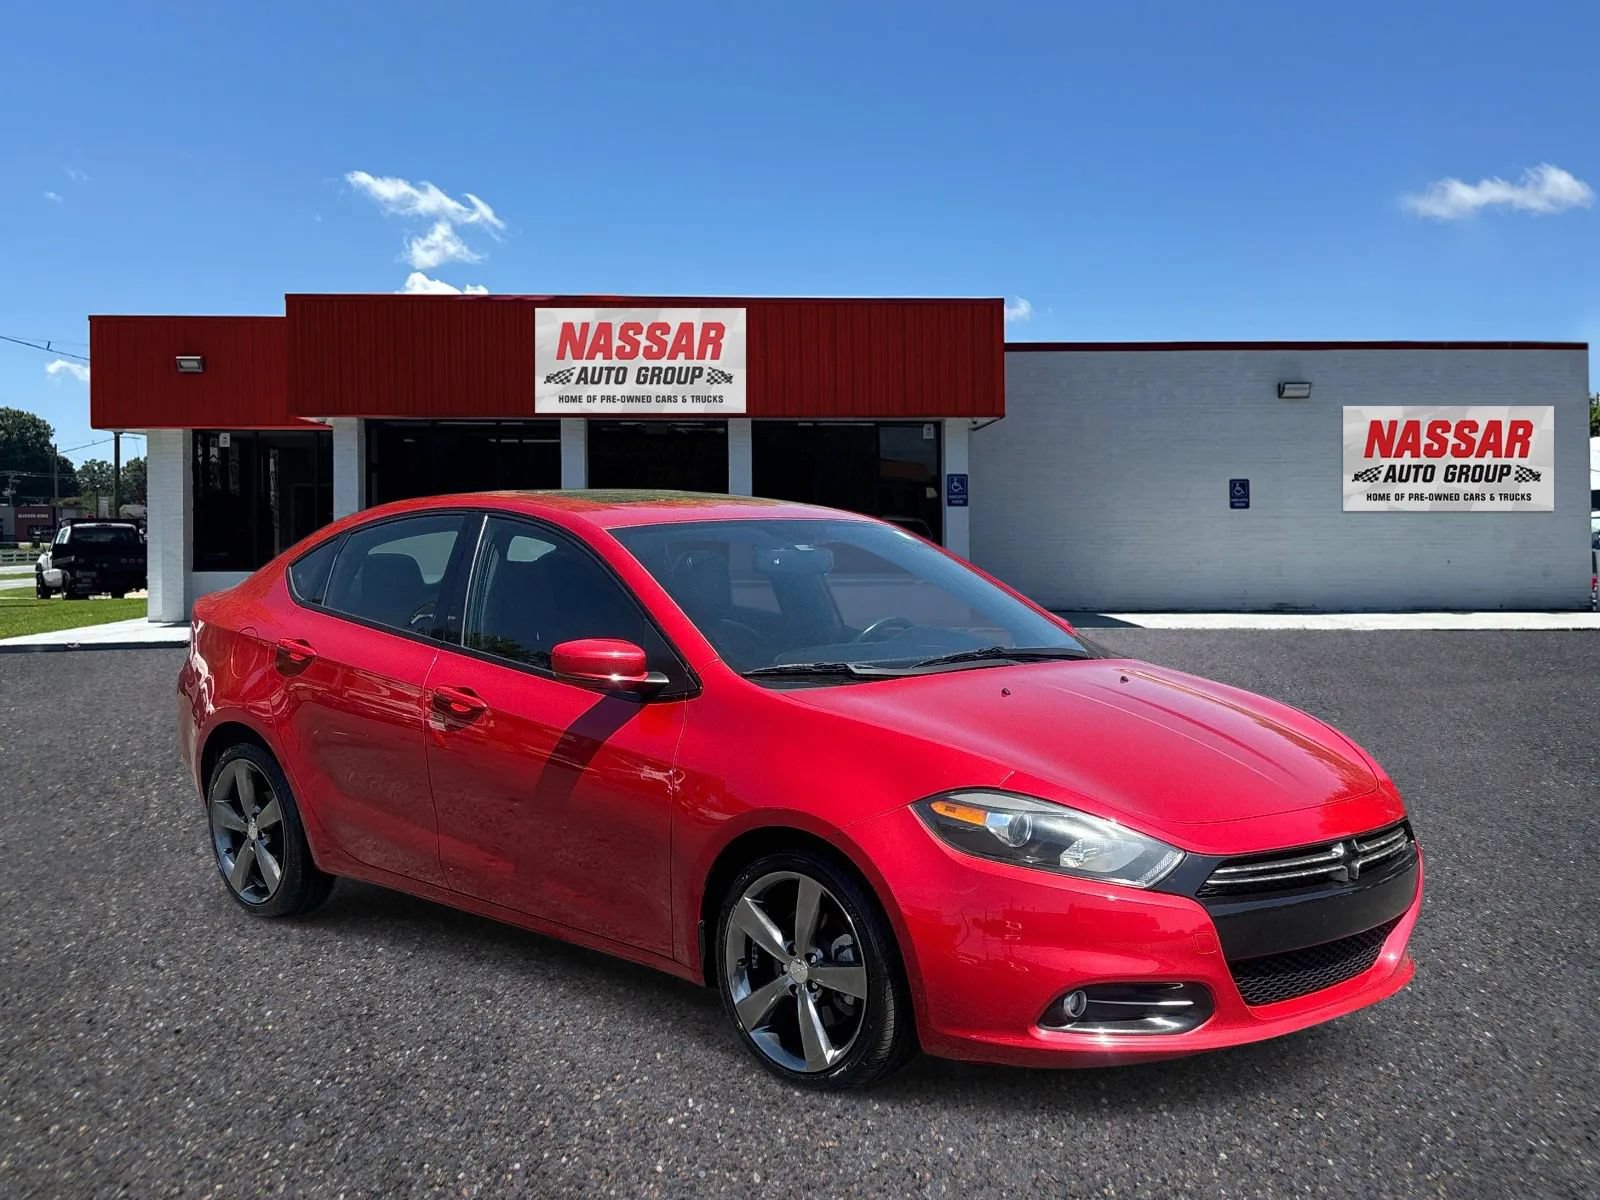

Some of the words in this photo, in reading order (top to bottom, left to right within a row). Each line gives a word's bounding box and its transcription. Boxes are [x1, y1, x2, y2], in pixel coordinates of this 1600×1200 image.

[556, 322, 726, 361] NASSAR
[575, 366, 628, 385] AUTO
[635, 366, 704, 385] GROUP
[558, 395, 583, 404] HOME
[586, 395, 598, 404] OF
[600, 395, 652, 404] PRE-OWNED
[655, 395, 678, 404] CARS
[690, 395, 724, 404] TRUCKS
[1364, 420, 1534, 459] NASSAR
[1383, 464, 1436, 483] AUTO
[1443, 464, 1512, 483] GROUP
[1366, 493, 1391, 502] HOME
[1394, 493, 1406, 502] OF
[1408, 493, 1460, 502] PRE-OWNED
[1463, 493, 1486, 502] CARS
[1498, 493, 1532, 502] TRUCKS
